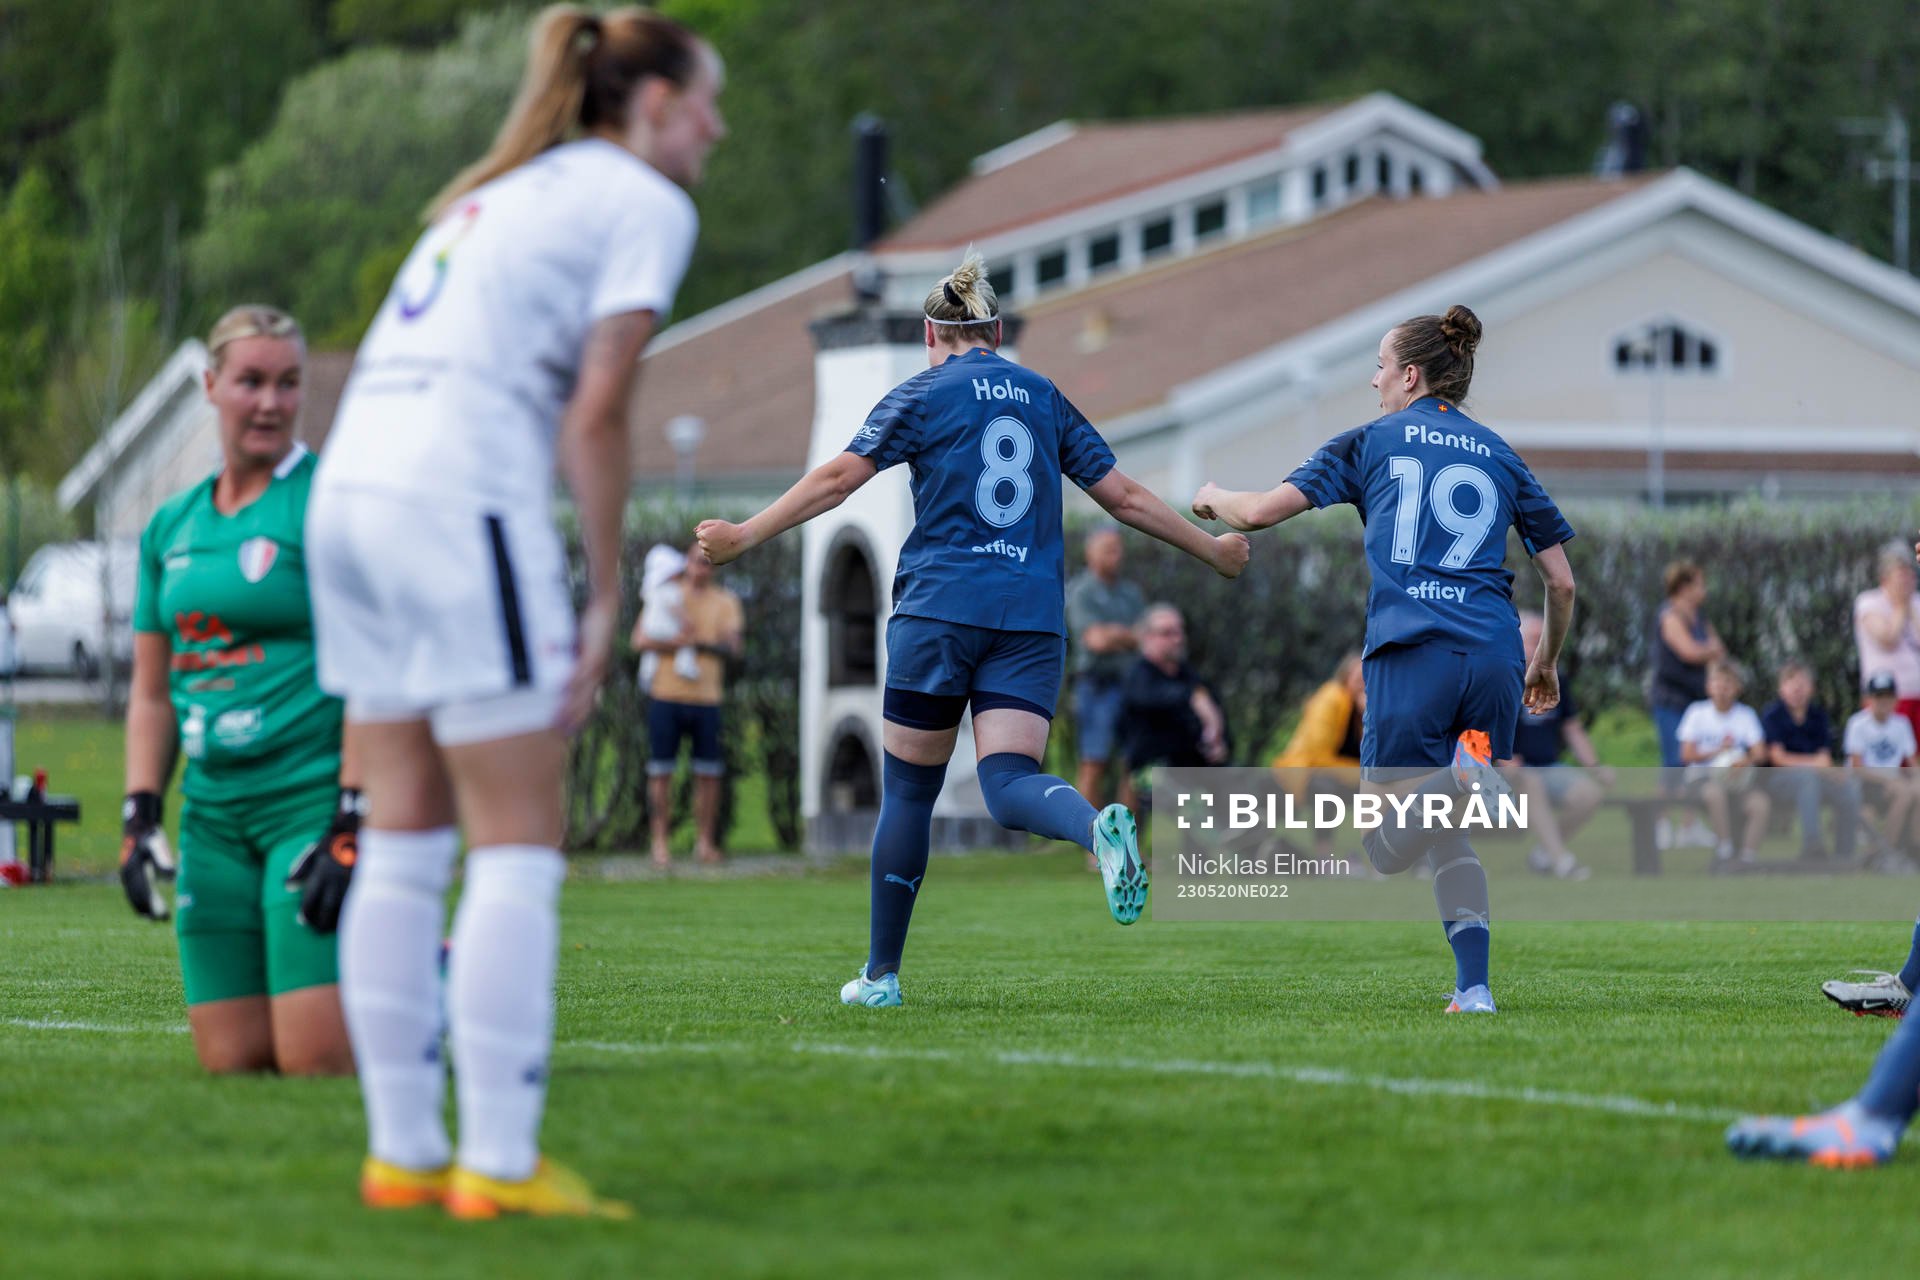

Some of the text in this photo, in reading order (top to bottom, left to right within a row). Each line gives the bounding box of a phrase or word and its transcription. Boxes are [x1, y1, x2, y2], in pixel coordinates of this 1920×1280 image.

[972, 378, 1030, 404] Holm
[1404, 425, 1491, 458] Plantin
[975, 415, 1035, 529] 8
[1389, 456, 1499, 569] 19
[1405, 580, 1466, 603] efficy
